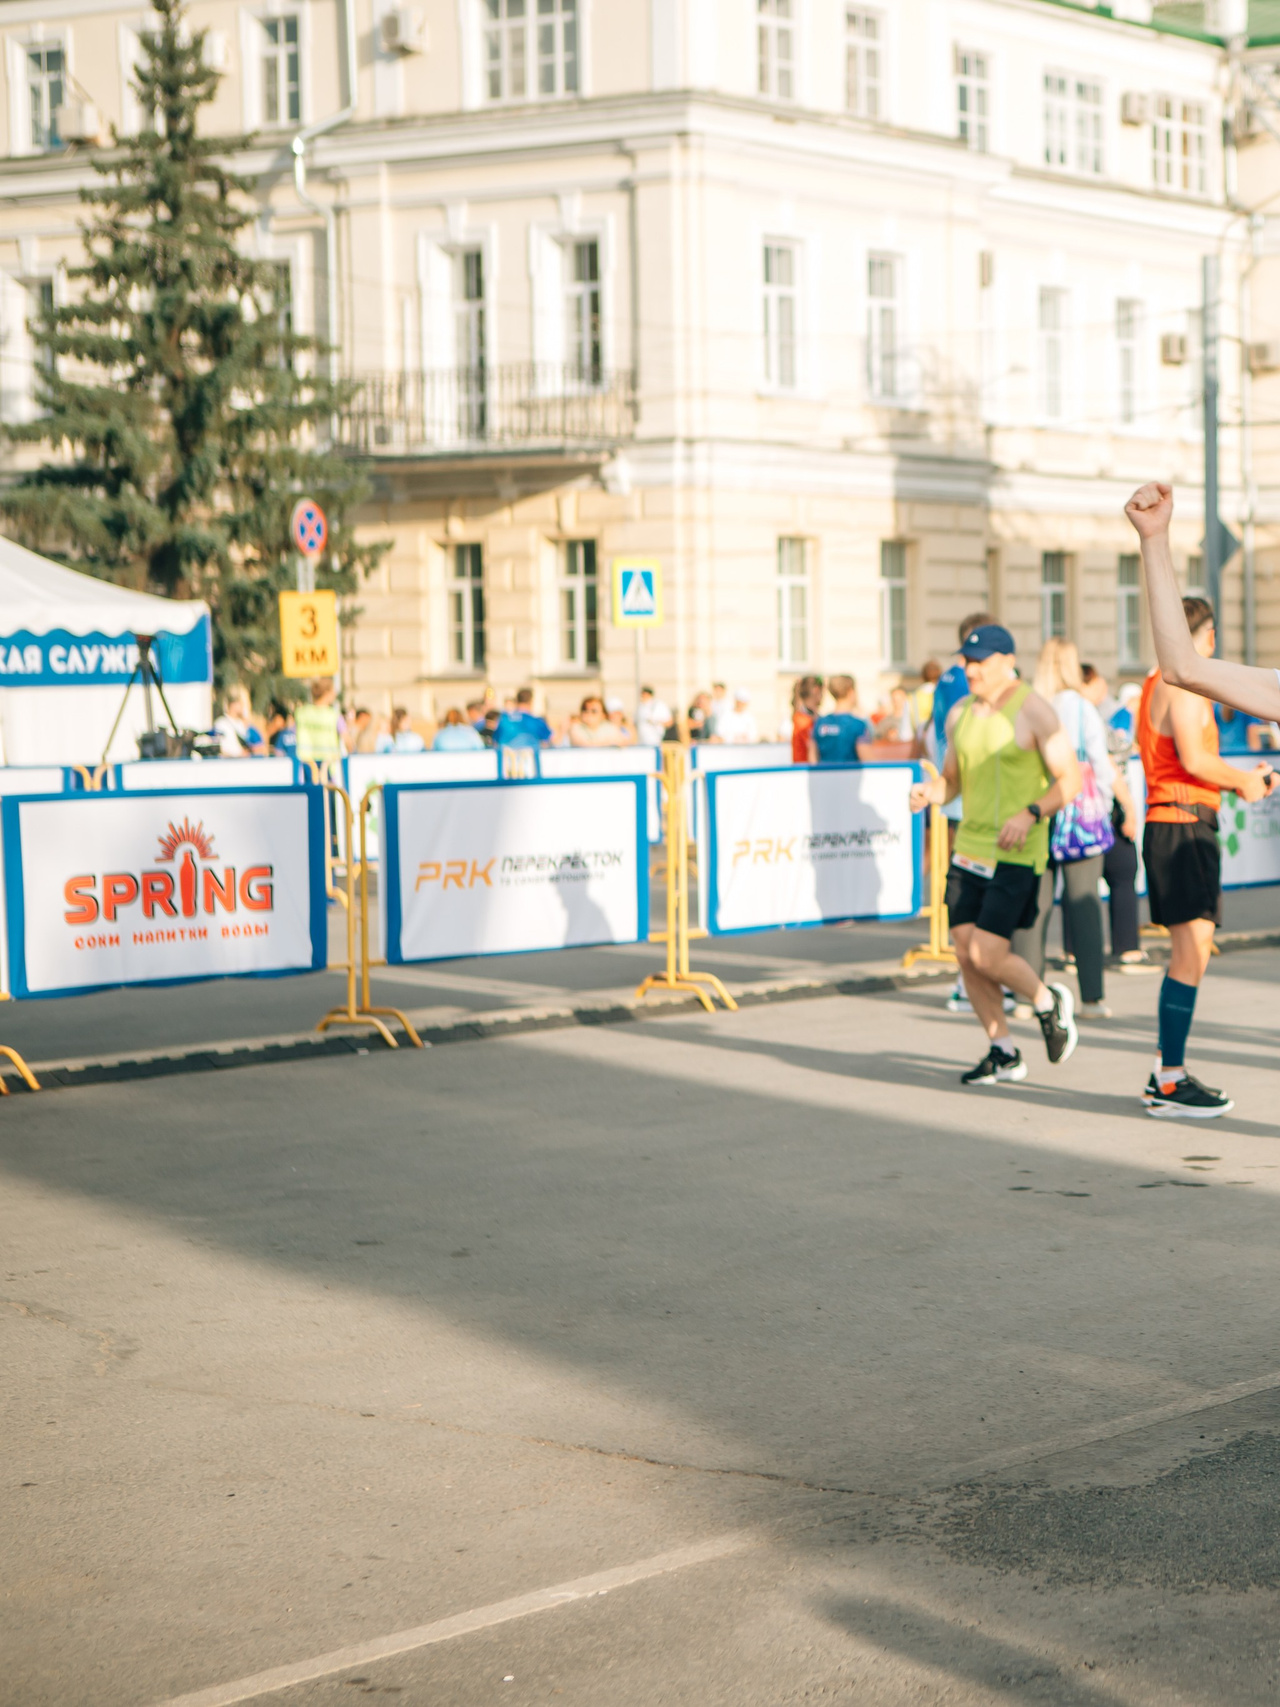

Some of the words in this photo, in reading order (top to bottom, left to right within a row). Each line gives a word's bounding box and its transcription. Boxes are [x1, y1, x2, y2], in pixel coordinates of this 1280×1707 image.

[300, 605, 317, 638] 3
[732, 836, 797, 868] PRK
[63, 851, 274, 923] SPRING
[415, 857, 497, 892] PRK
[74, 933, 120, 950] СОКИ
[133, 926, 208, 945] НАПИТКИ
[221, 922, 269, 938] ВОДЫ
